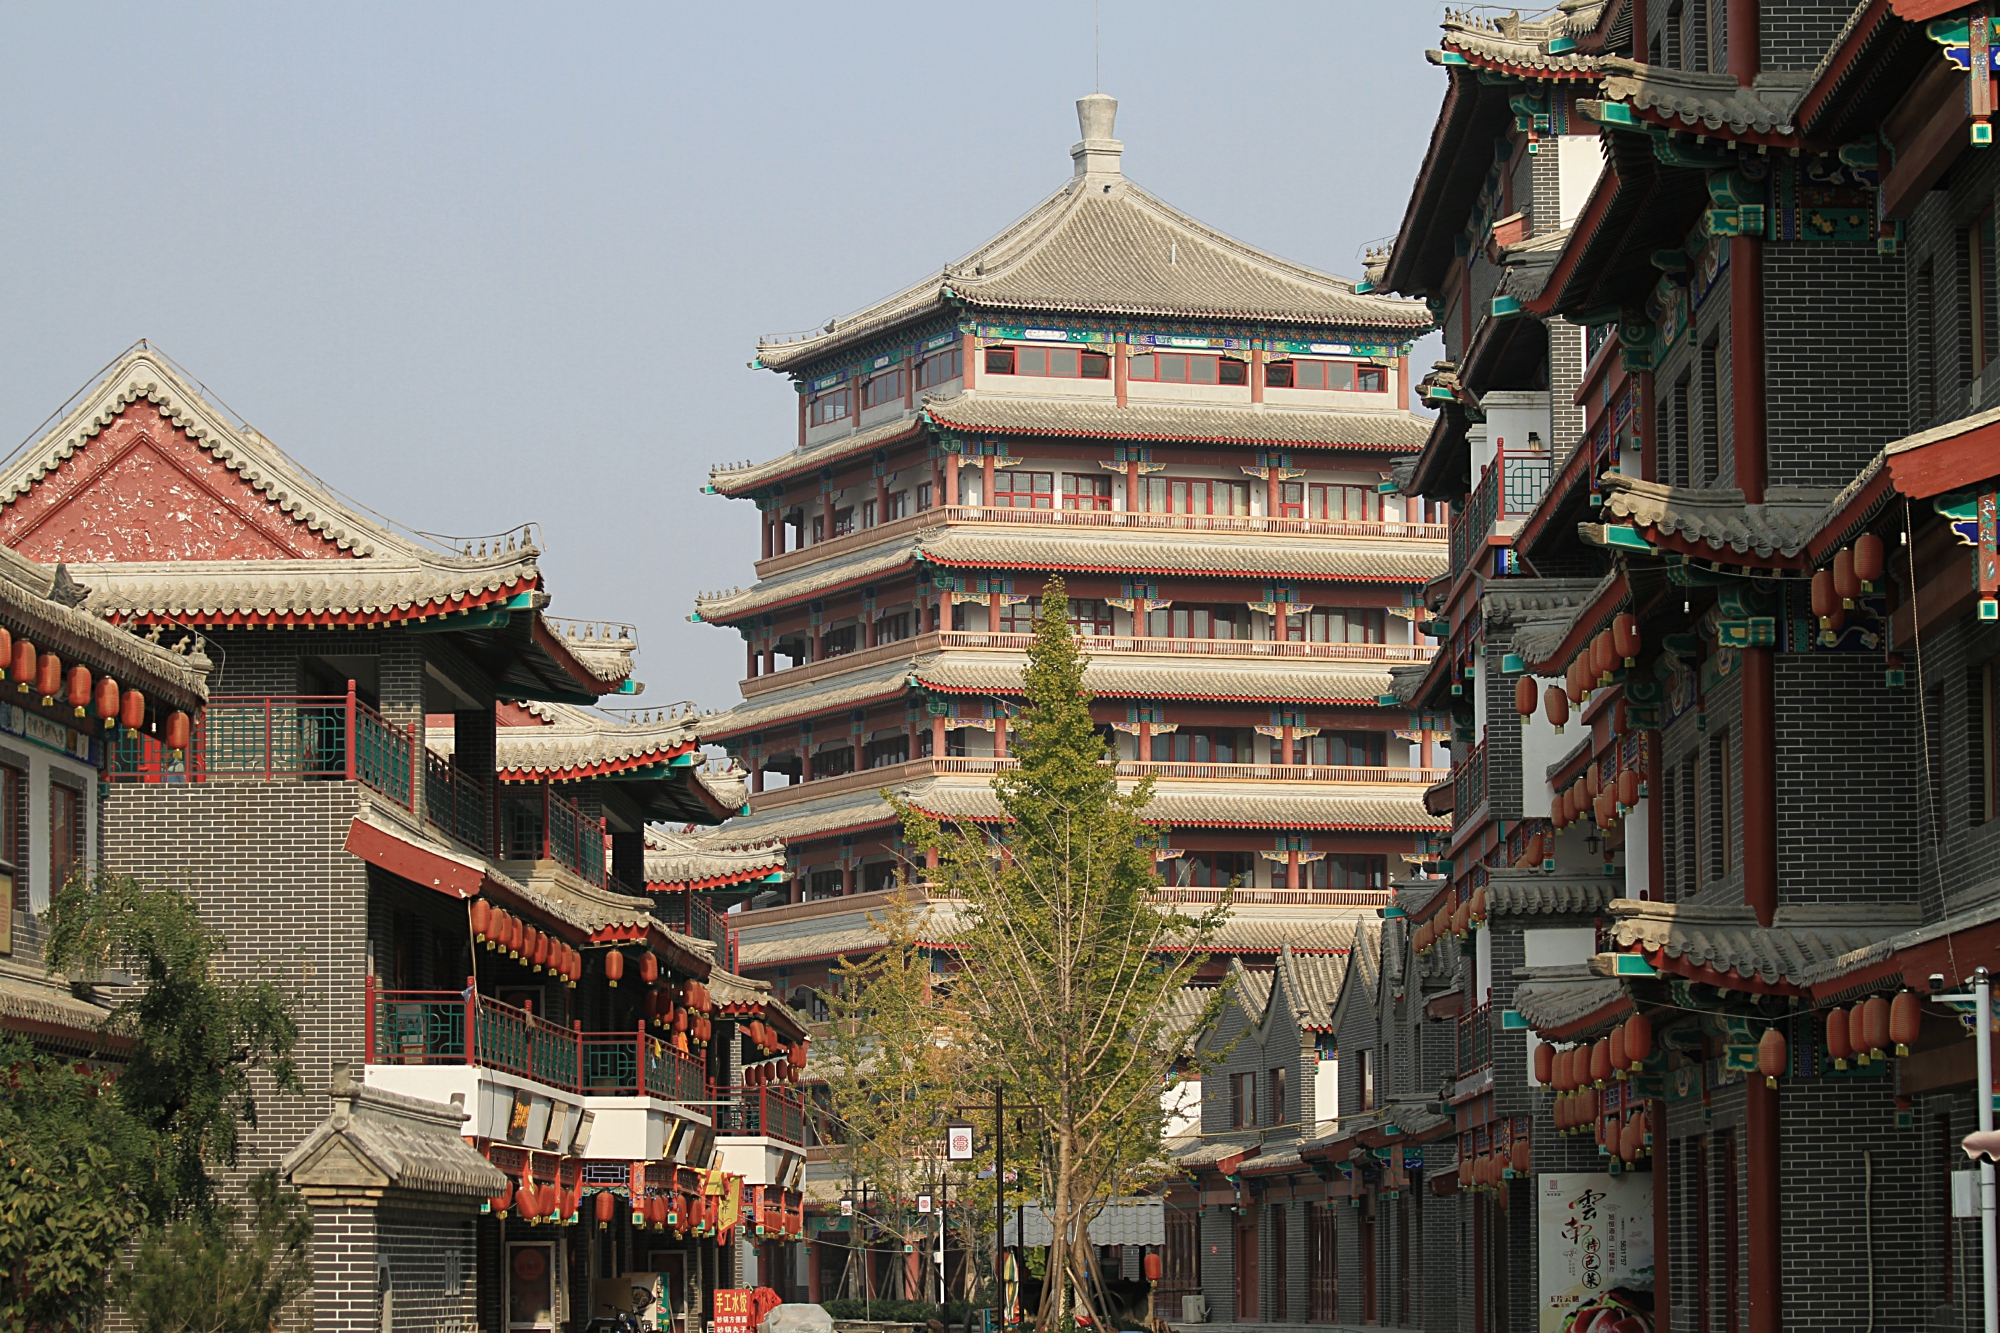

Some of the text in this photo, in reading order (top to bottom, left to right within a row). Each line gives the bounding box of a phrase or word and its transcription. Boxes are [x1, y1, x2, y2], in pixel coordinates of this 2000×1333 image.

[1561, 1189, 1606, 1244] 雲南
[1583, 1236, 1600, 1288] 特色菜
[716, 1292, 747, 1313] 手工水饺
